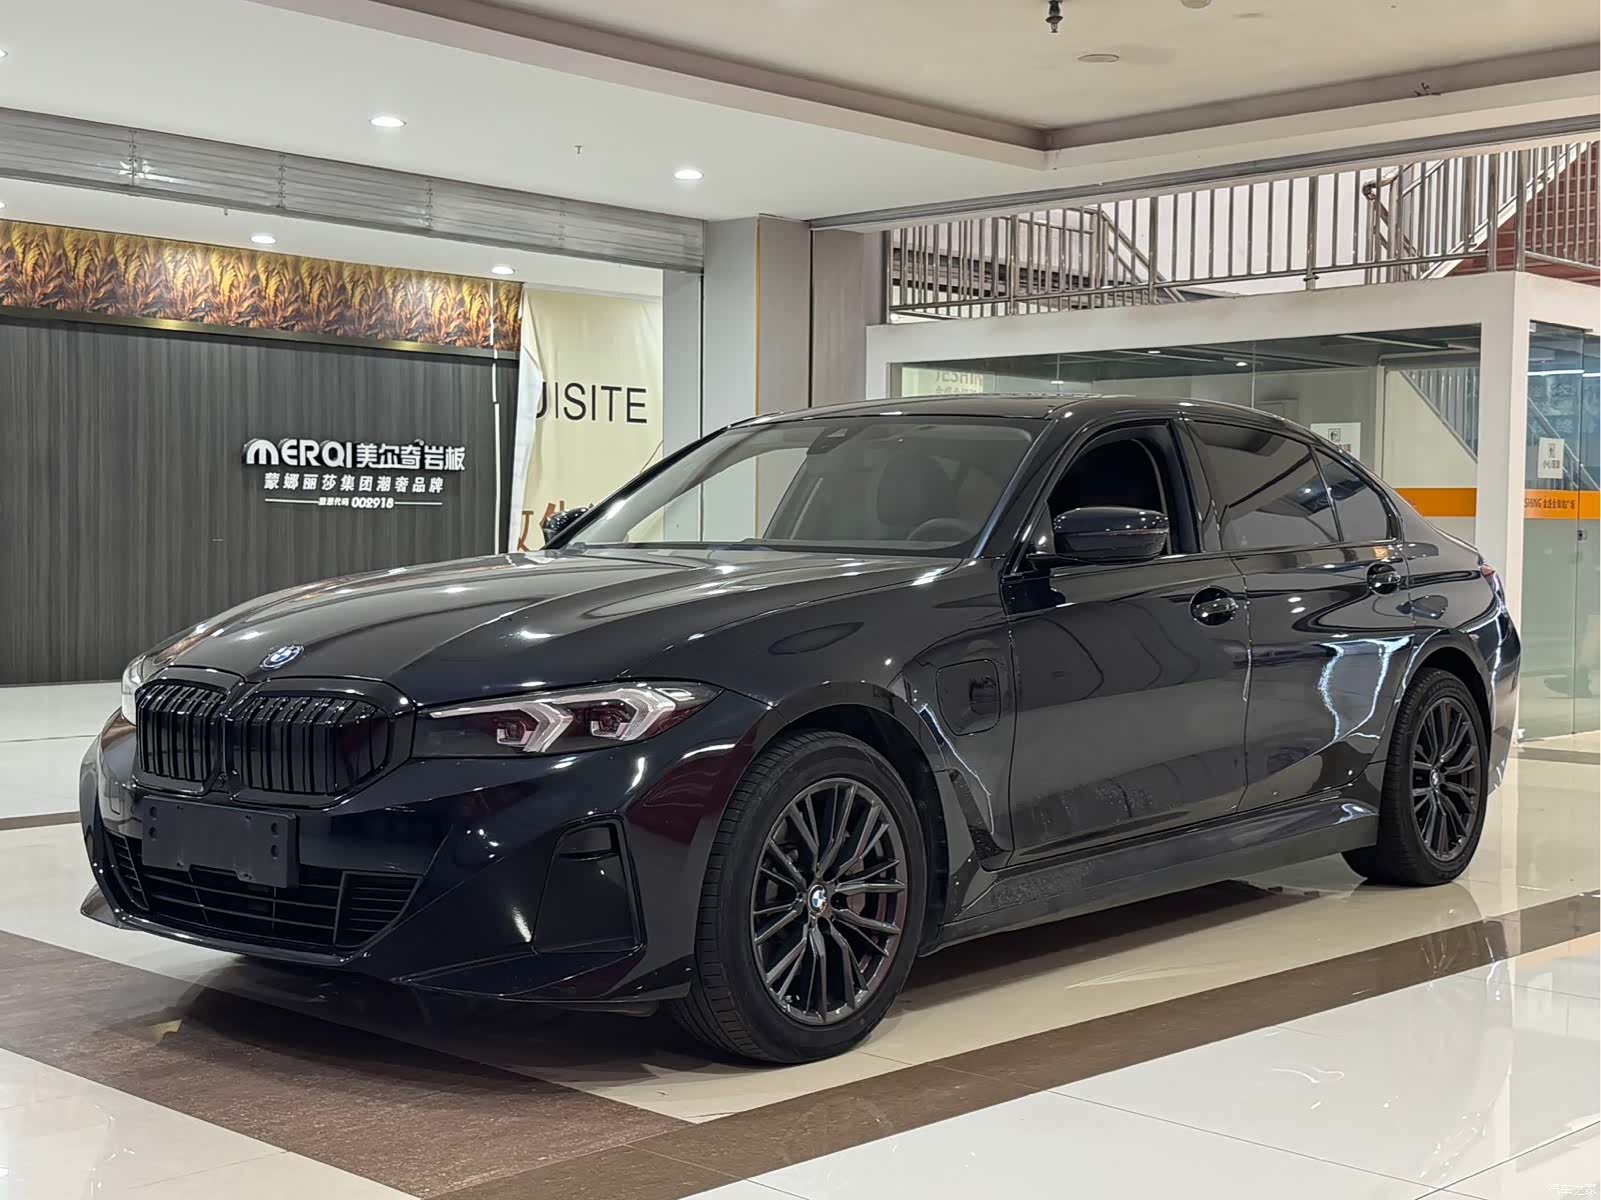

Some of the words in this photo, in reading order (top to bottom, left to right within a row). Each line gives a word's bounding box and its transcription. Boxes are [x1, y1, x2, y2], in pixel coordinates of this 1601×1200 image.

[245, 438, 352, 469] MERQI
[356, 443, 466, 471] 美尔奇岩板
[263, 472, 444, 493] 蒙娜丽莎集团潮奢品牌
[351, 496, 394, 509] 002918
